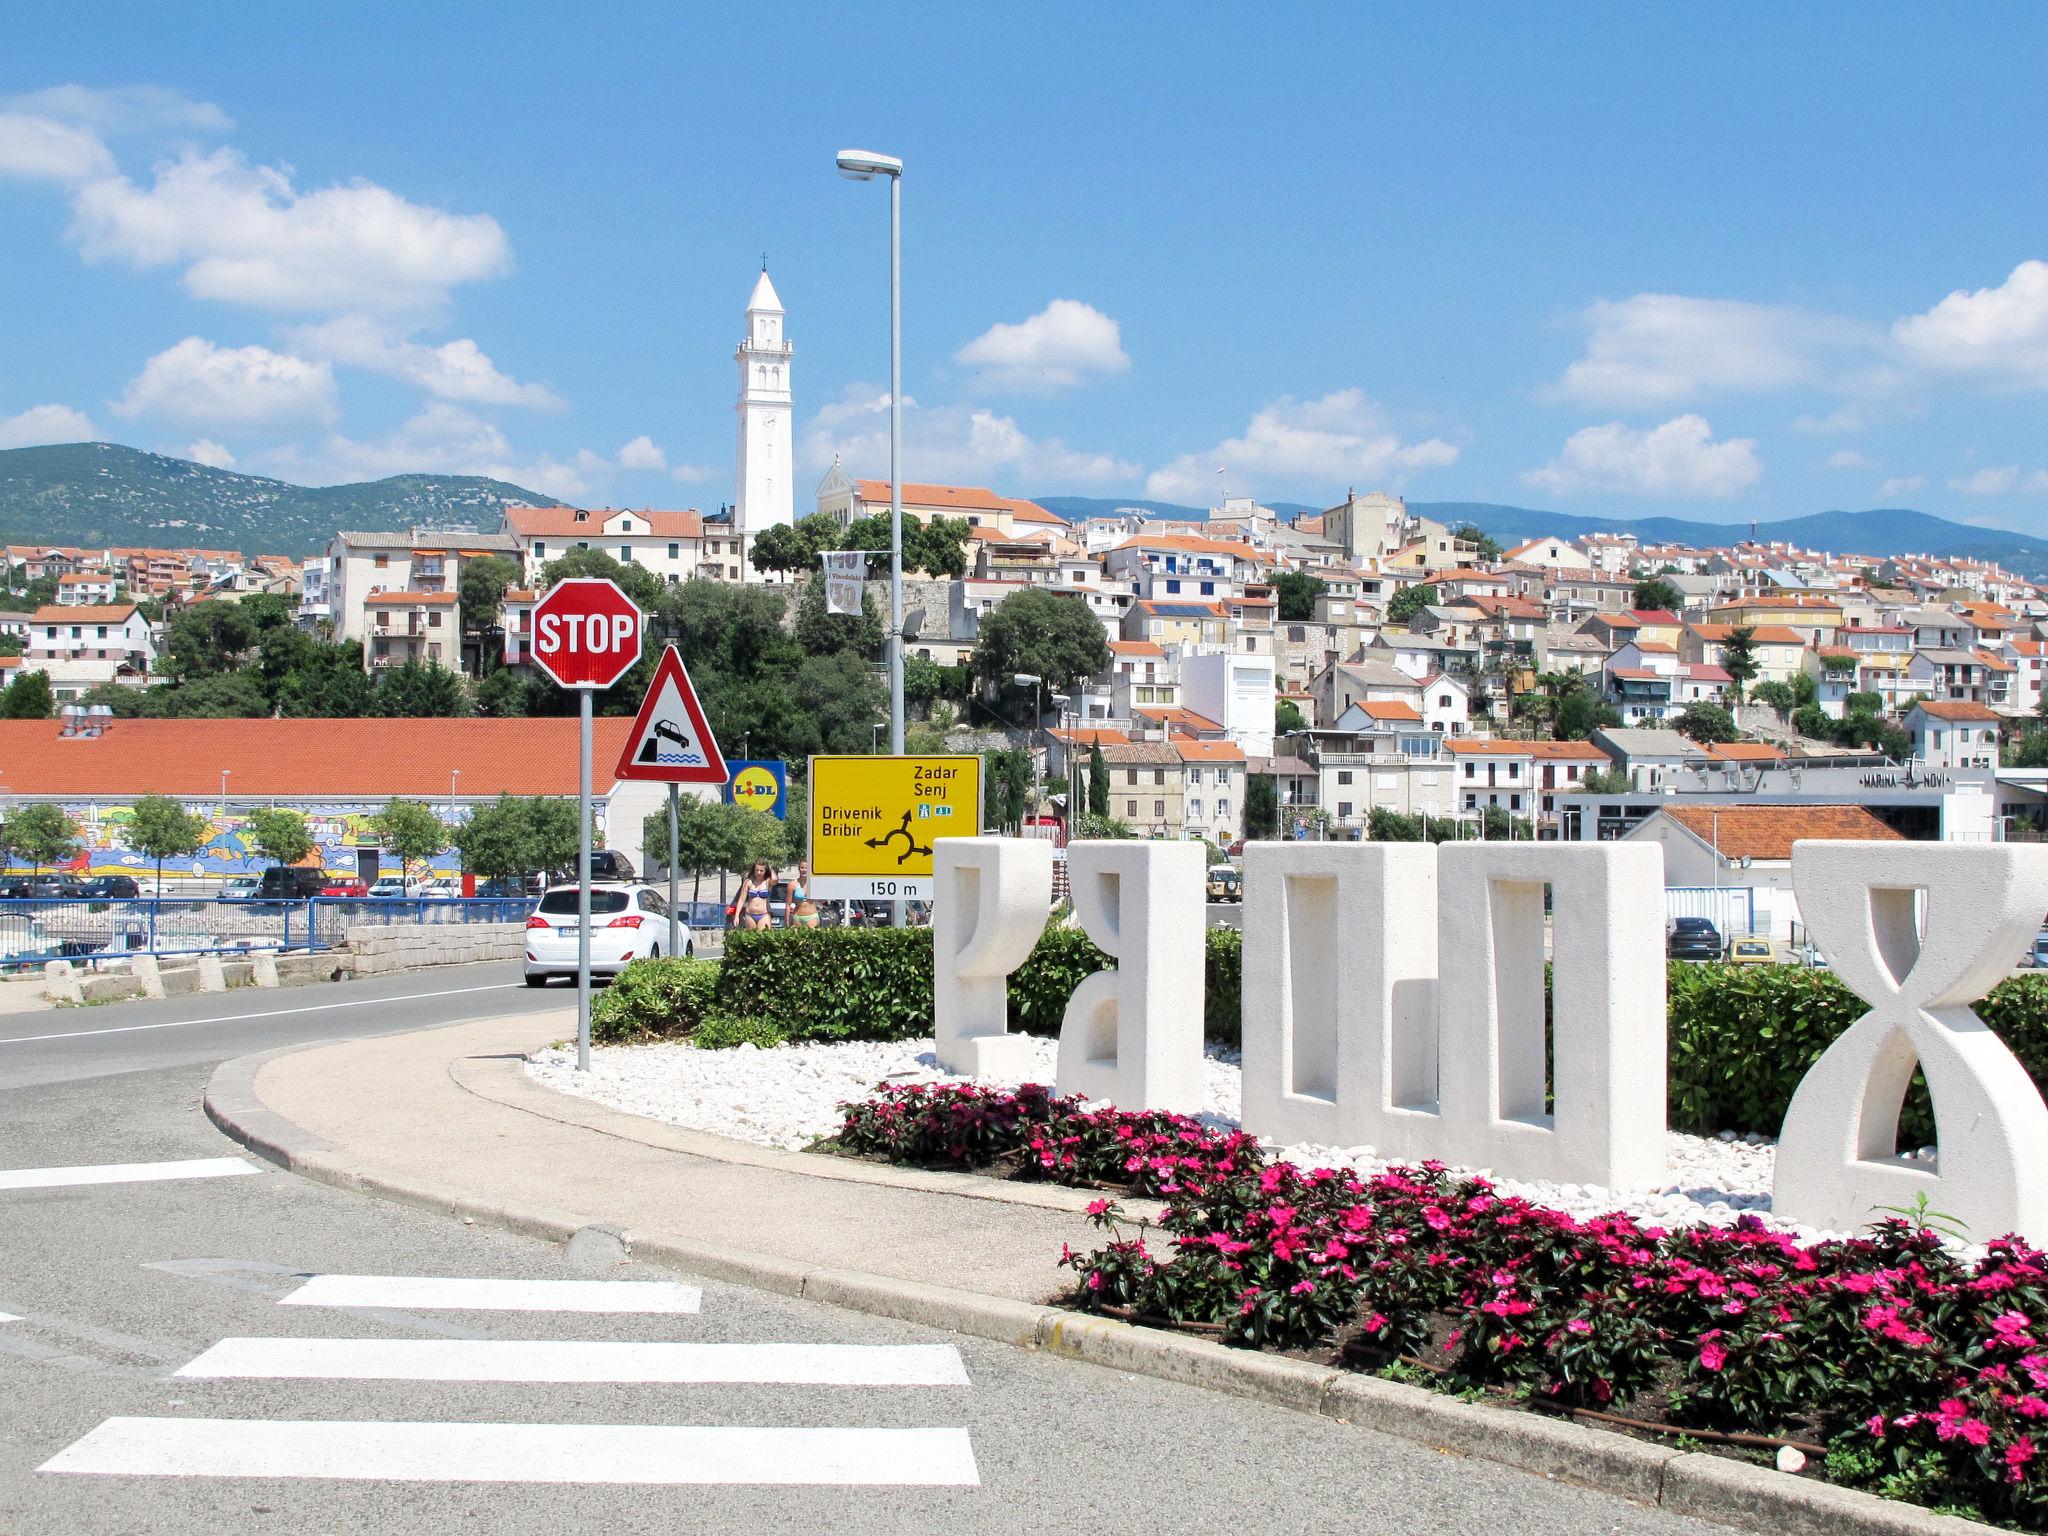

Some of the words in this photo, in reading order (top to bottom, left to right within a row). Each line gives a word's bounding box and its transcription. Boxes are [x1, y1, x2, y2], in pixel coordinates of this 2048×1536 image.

[539, 613, 634, 654] STOP
[914, 766, 958, 779] Zadar
[1864, 773, 1897, 788] MARINA
[1924, 773, 1945, 788] NOVI
[914, 783, 947, 799] Senj
[822, 806, 882, 820] Drivenik
[822, 823, 863, 837] Bribir
[870, 882, 896, 895] 150
[904, 885, 917, 895] m
